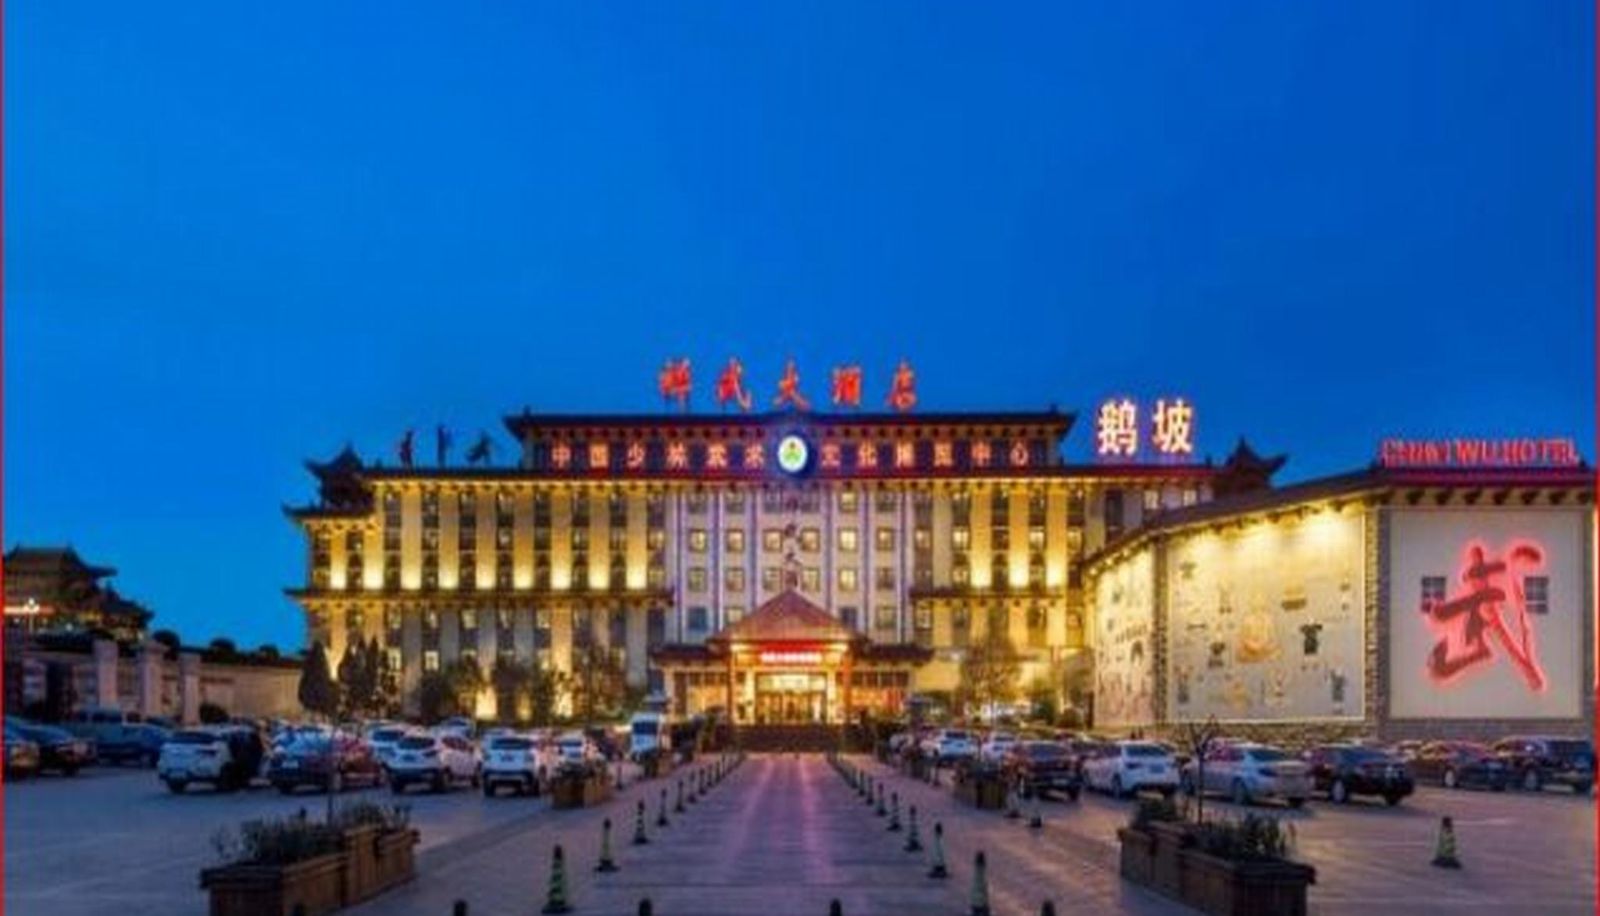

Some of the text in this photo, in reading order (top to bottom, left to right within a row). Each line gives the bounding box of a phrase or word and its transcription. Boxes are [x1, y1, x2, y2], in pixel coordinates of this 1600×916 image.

[1098, 399, 1193, 454] 鹅坡
[1503, 439, 1578, 465] HOTEL
[1425, 541, 1544, 692] 武
